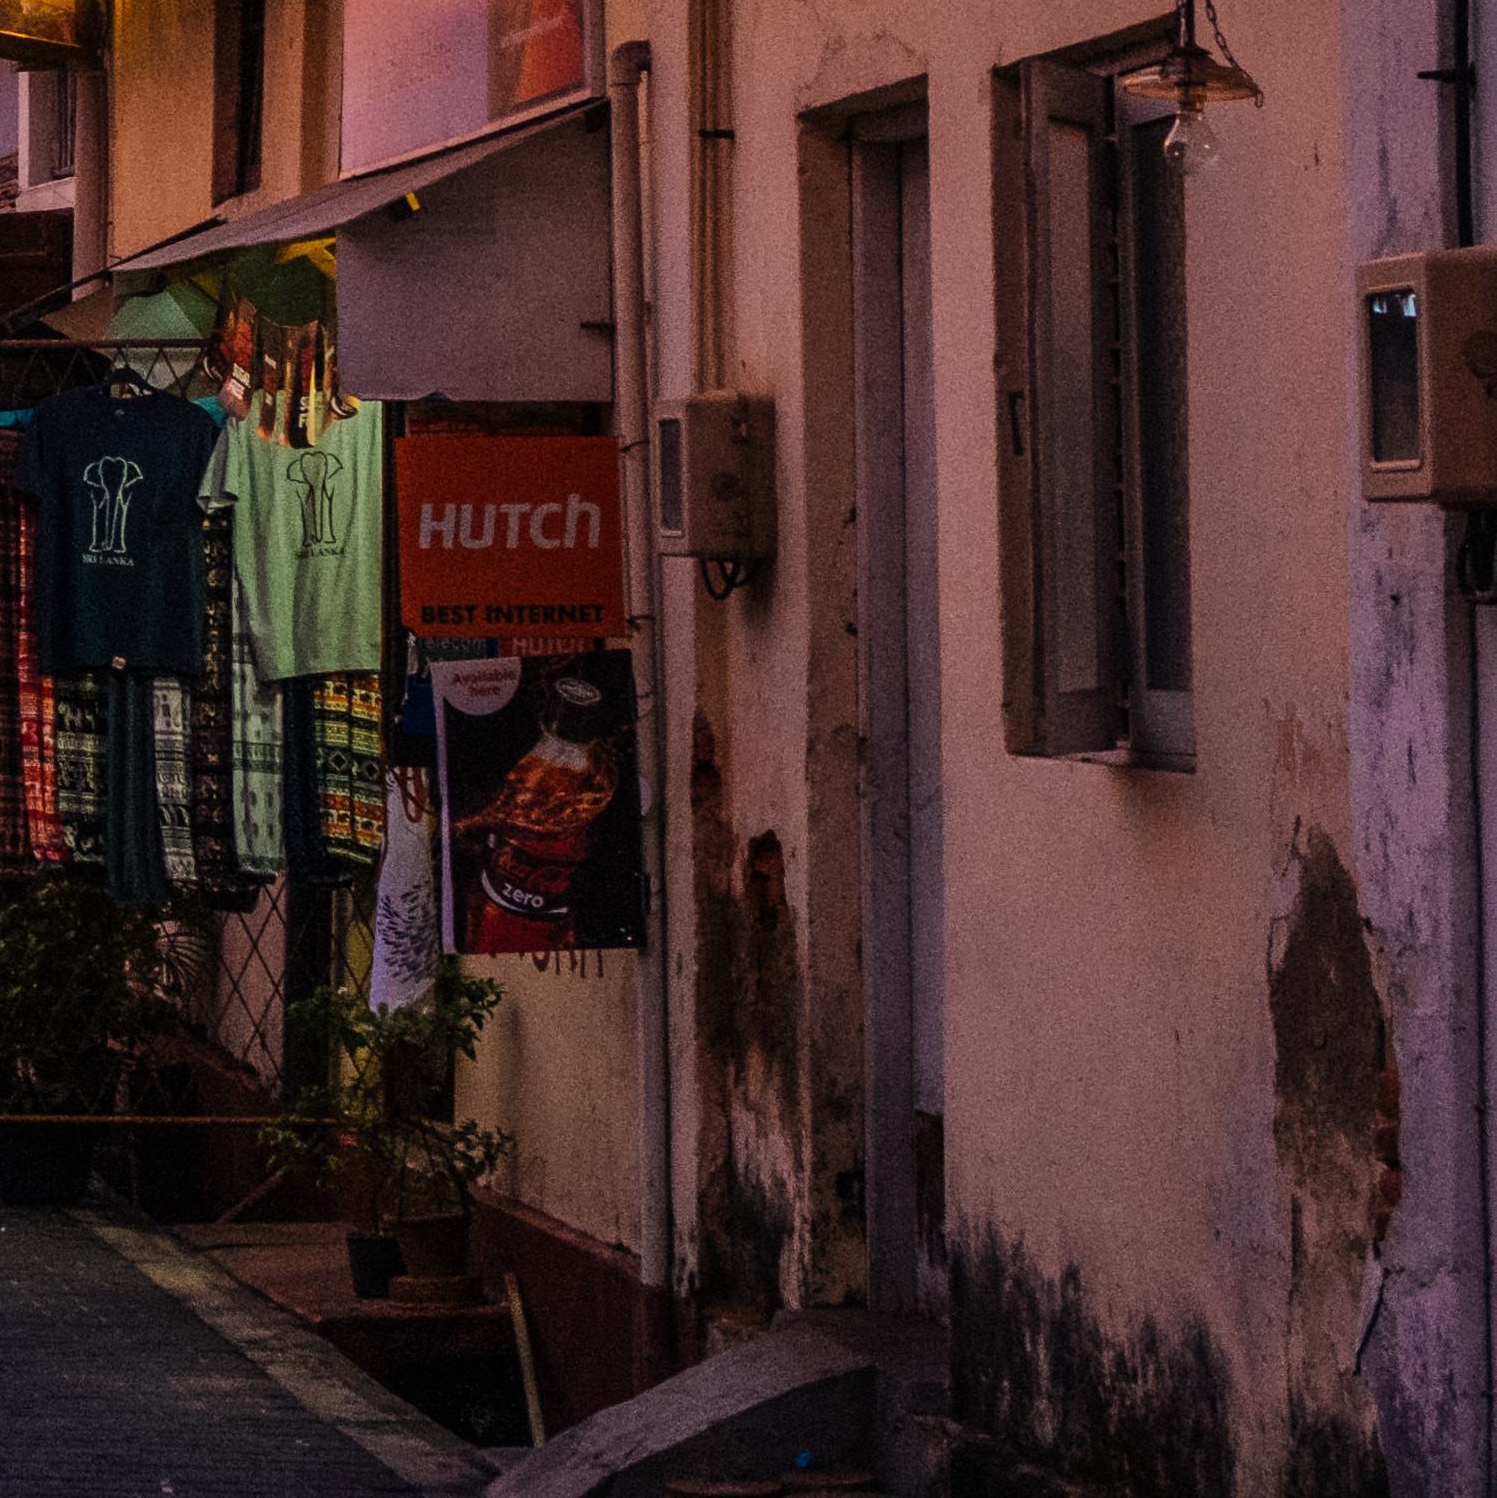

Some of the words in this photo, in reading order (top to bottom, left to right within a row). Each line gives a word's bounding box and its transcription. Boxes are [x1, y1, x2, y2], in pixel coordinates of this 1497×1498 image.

[81, 553, 97, 564] SRI
[99, 555, 135, 567] LANKA
[420, 605, 477, 624] BEST
[484, 604, 604, 623] INTERNET
[452, 669, 517, 685] Available
[468, 684, 501, 697] here
[501, 882, 545, 909] zero
